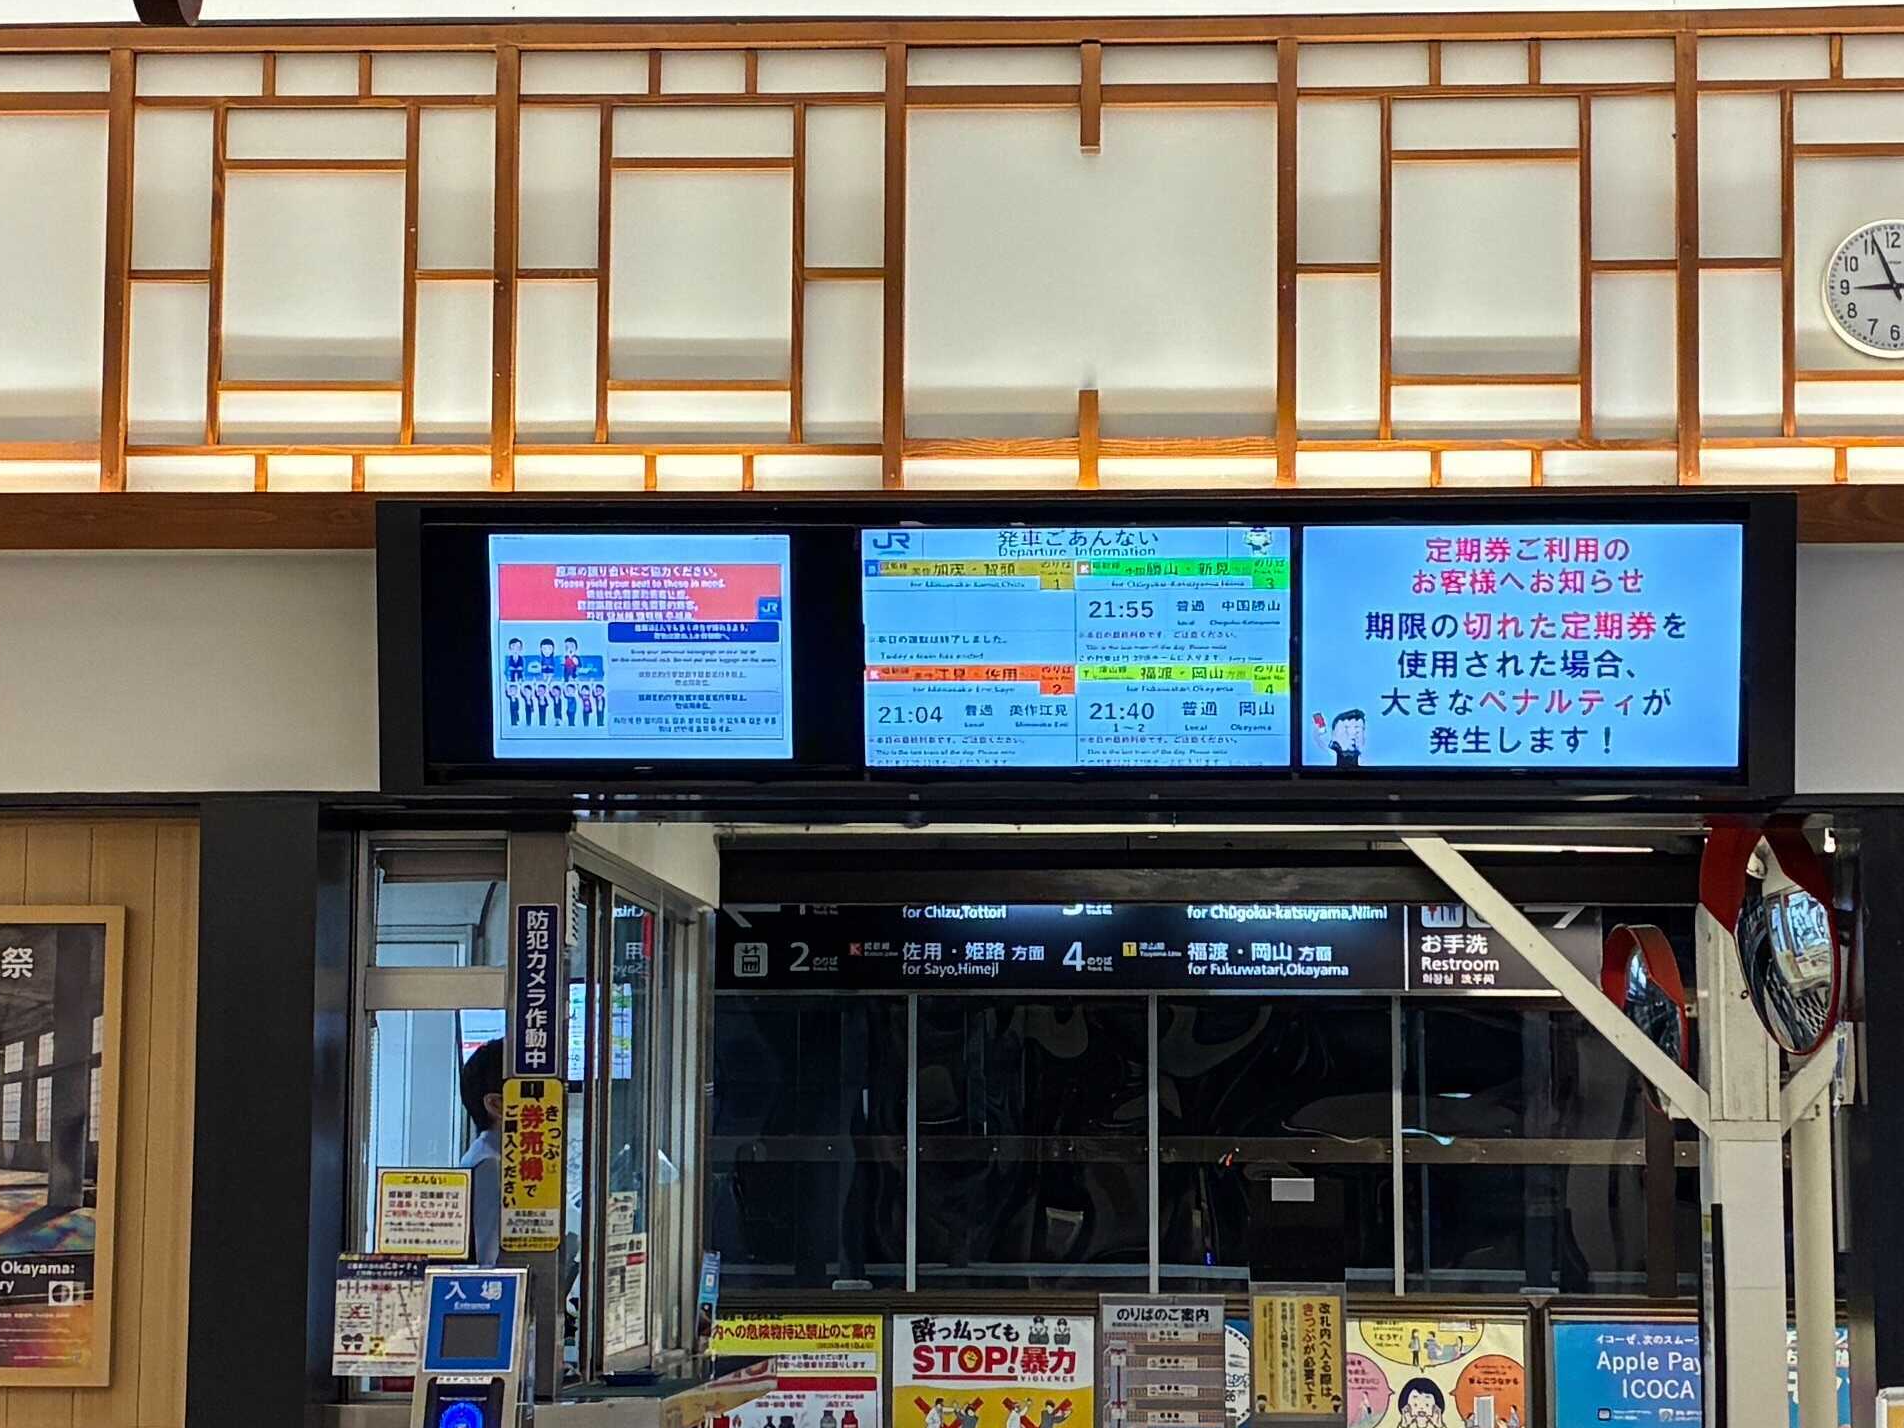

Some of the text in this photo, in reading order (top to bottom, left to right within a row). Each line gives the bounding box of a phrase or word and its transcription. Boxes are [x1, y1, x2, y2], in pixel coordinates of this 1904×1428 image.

[1886, 231, 1901, 249] 12
[1844, 256, 1860, 273] 10
[1839, 279, 1851, 296] 9
[1847, 302, 1858, 319] 8
[1867, 318, 1879, 336] 7
[1890, 324, 1901, 341] 6
[873, 532, 911, 549] JR
[998, 529, 1159, 548] 発車ごあんない
[998, 546, 1156, 557] Departure Information
[1425, 537, 1630, 563] 定期券ご利用の
[1265, 577, 1275, 590] 3
[1412, 568, 1645, 595] お客様へお知らせ
[762, 602, 779, 613] JR
[1089, 600, 1281, 618] 21:55 普通 中国勝山
[1365, 612, 1687, 640] 期限の切れた定期券を
[1397, 650, 1638, 679] 使用された場合、
[1052, 683, 1062, 695] 2
[1265, 683, 1274, 695] 4
[1089, 701, 1275, 720] 21:40 普通 岡山
[1381, 687, 1672, 717] 大きなペナルティが
[878, 705, 944, 724] 21:04
[1429, 725, 1614, 754] 発生します！
[902, 907, 922, 919] for
[1187, 906, 1208, 919] for
[1420, 934, 1488, 955] お手洗
[789, 942, 810, 972] 2
[902, 941, 1006, 962] 佐用・姫路
[1011, 945, 1045, 961] 方面
[1062, 942, 1085, 972] 4
[1187, 941, 1293, 962] 福渡・岡山
[1298, 945, 1333, 962] 方面
[1421, 956, 1500, 972] Restroom
[902, 962, 1000, 977] for Sayo,Himeji
[1187, 962, 1349, 978] for Fukuwatari,Okayama
[525, 910, 550, 1069] 防犯カメラ作動中
[503, 1105, 518, 1209] ご購入ください
[518, 1103, 544, 1198] 券売機で
[1, 1260, 76, 1277] Okayama:
[1116, 1308, 1210, 1323] のりばのご案内
[910, 1316, 1020, 1344] 酔っ払っても
[1302, 1302, 1317, 1410] きっぷが必要です。
[1318, 1302, 1333, 1398] 改札内へ入る際は
[1597, 1351, 1659, 1373] Apple
[1020, 1375, 1075, 1383] VIOLENCE
[1622, 1379, 1695, 1400] ICOCA
